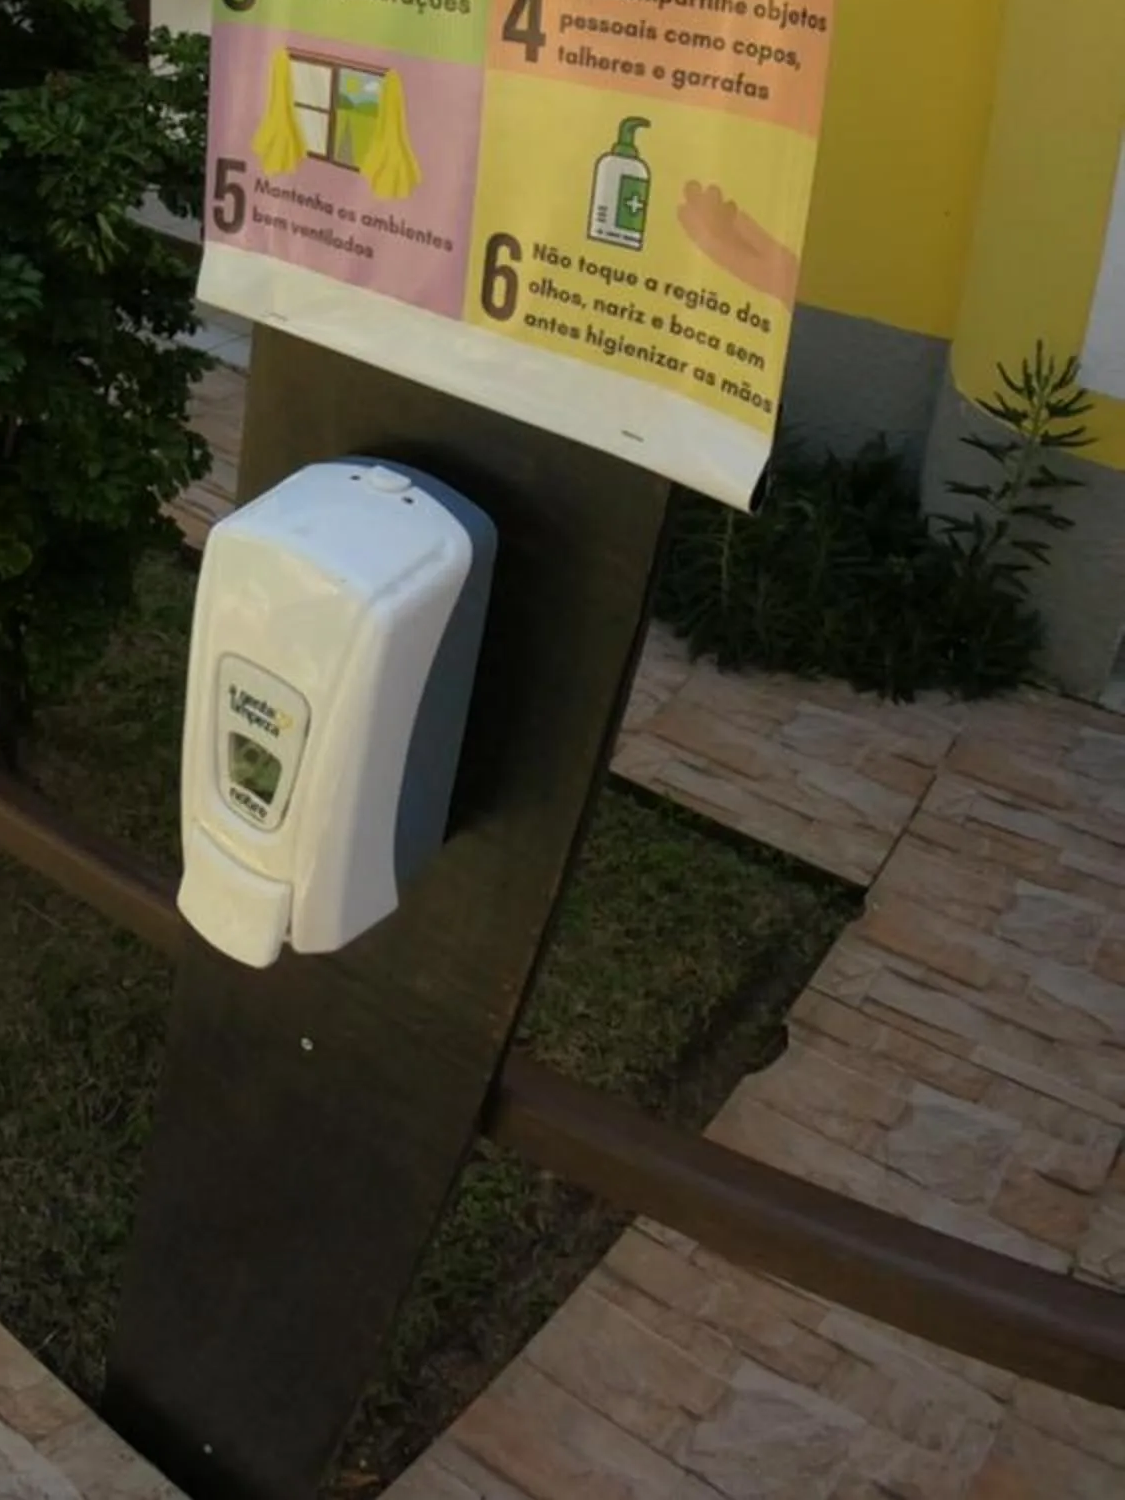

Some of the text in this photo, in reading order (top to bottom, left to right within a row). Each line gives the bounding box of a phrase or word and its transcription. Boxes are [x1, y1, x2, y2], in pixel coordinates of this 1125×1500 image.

[557, 44, 769, 101] talheres e garrafas
[559, 11, 802, 71] pessoais como copos,
[213, 157, 247, 235] 5
[252, 206, 375, 260] bem ventilados
[254, 177, 334, 216] Mantenha
[361, 213, 454, 252] ambientes
[481, 232, 523, 322] 6
[532, 242, 772, 333] Não toque a região dos
[524, 311, 774, 415] antes higienizar as mãos
[528, 277, 766, 372] olhos, nariz e boca sem
